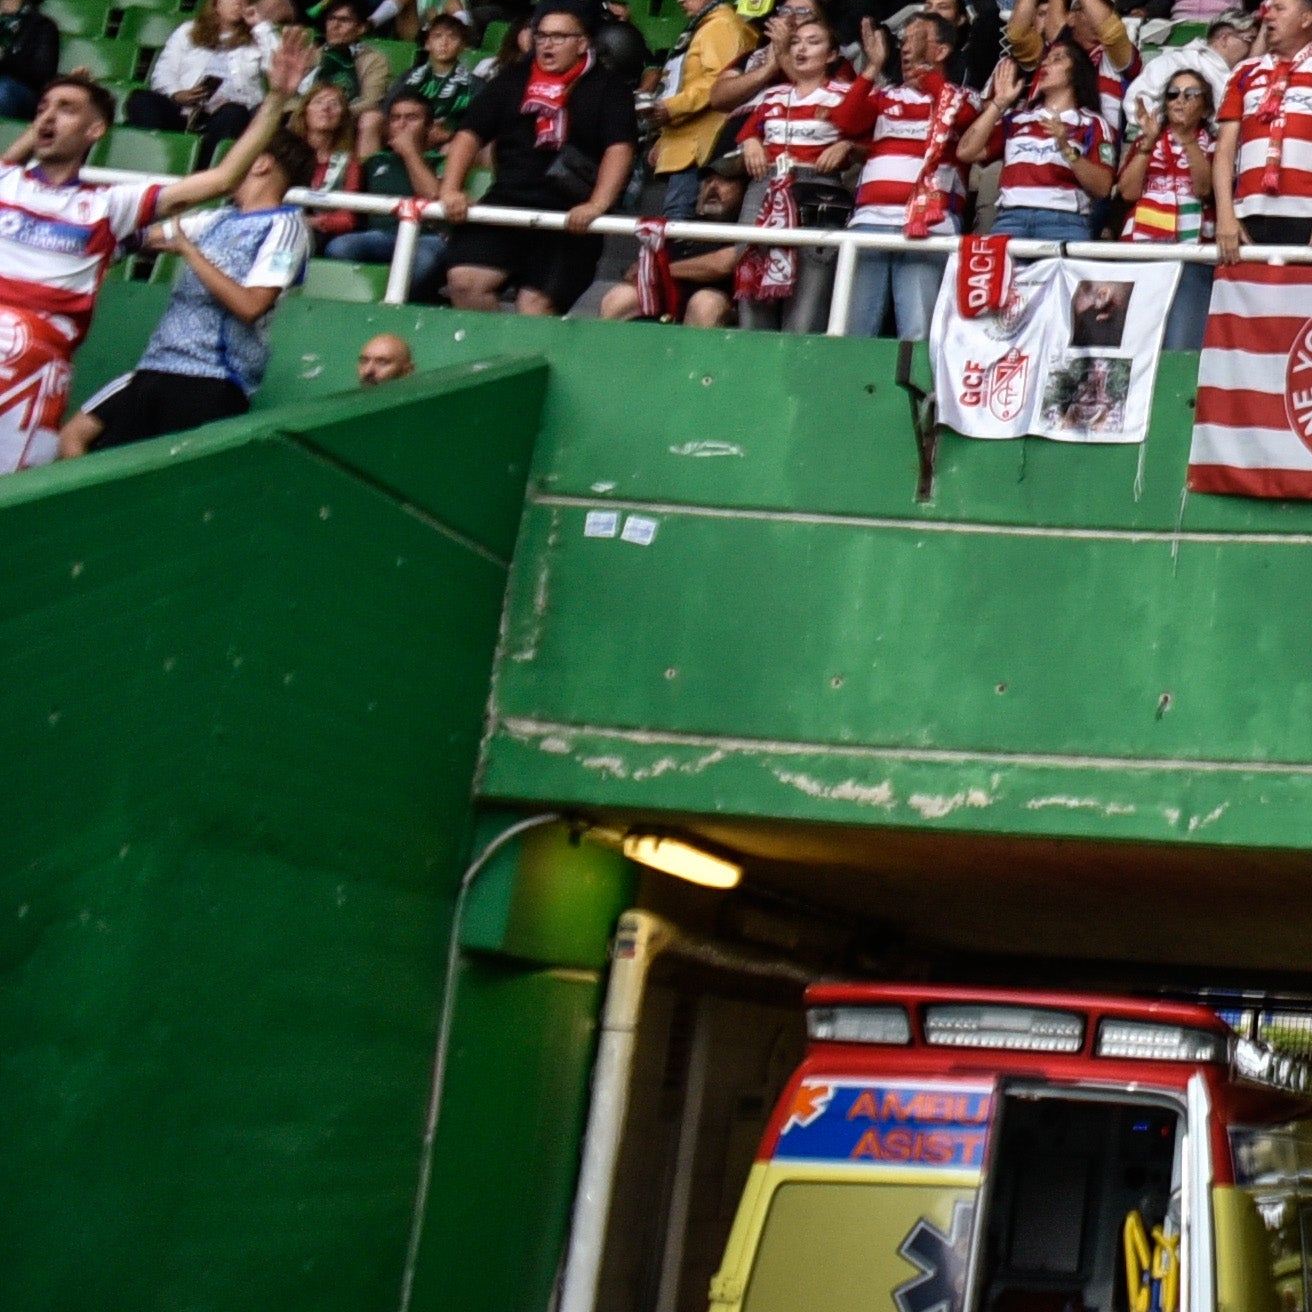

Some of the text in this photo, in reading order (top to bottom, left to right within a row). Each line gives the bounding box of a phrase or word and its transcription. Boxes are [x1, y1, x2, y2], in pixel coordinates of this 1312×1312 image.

[959, 359, 986, 407] GCF
[846, 1090, 989, 1125] AMBU
[850, 1127, 984, 1166] ASIST
